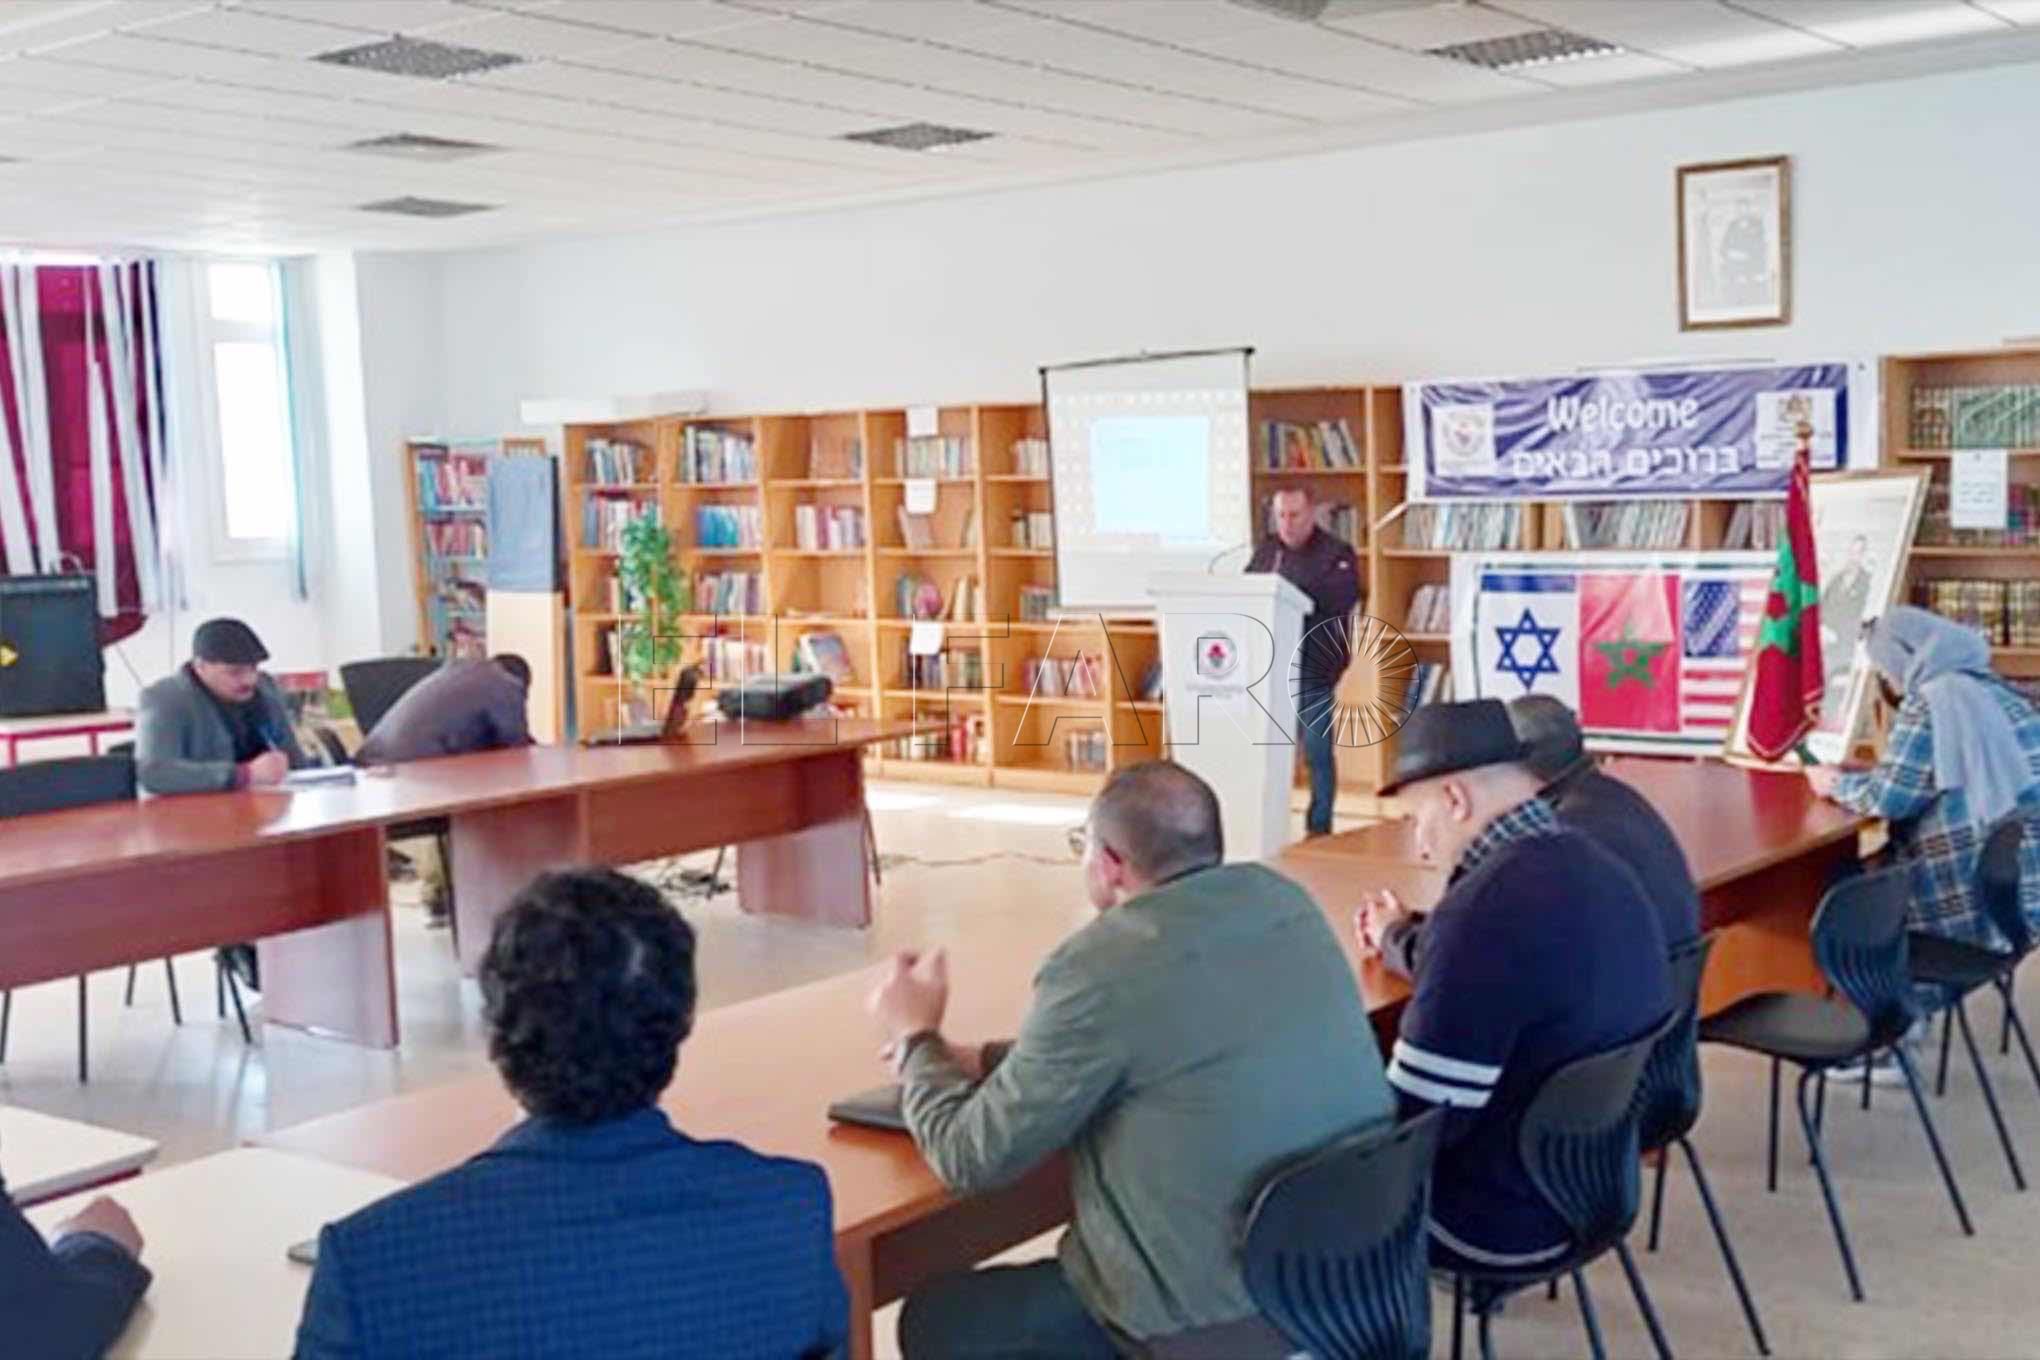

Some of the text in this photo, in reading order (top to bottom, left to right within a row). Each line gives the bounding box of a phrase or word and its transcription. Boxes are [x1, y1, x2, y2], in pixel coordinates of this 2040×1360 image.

[1548, 396, 1699, 432] Welcome
[1513, 445, 1741, 478] ברוכים הבאים
